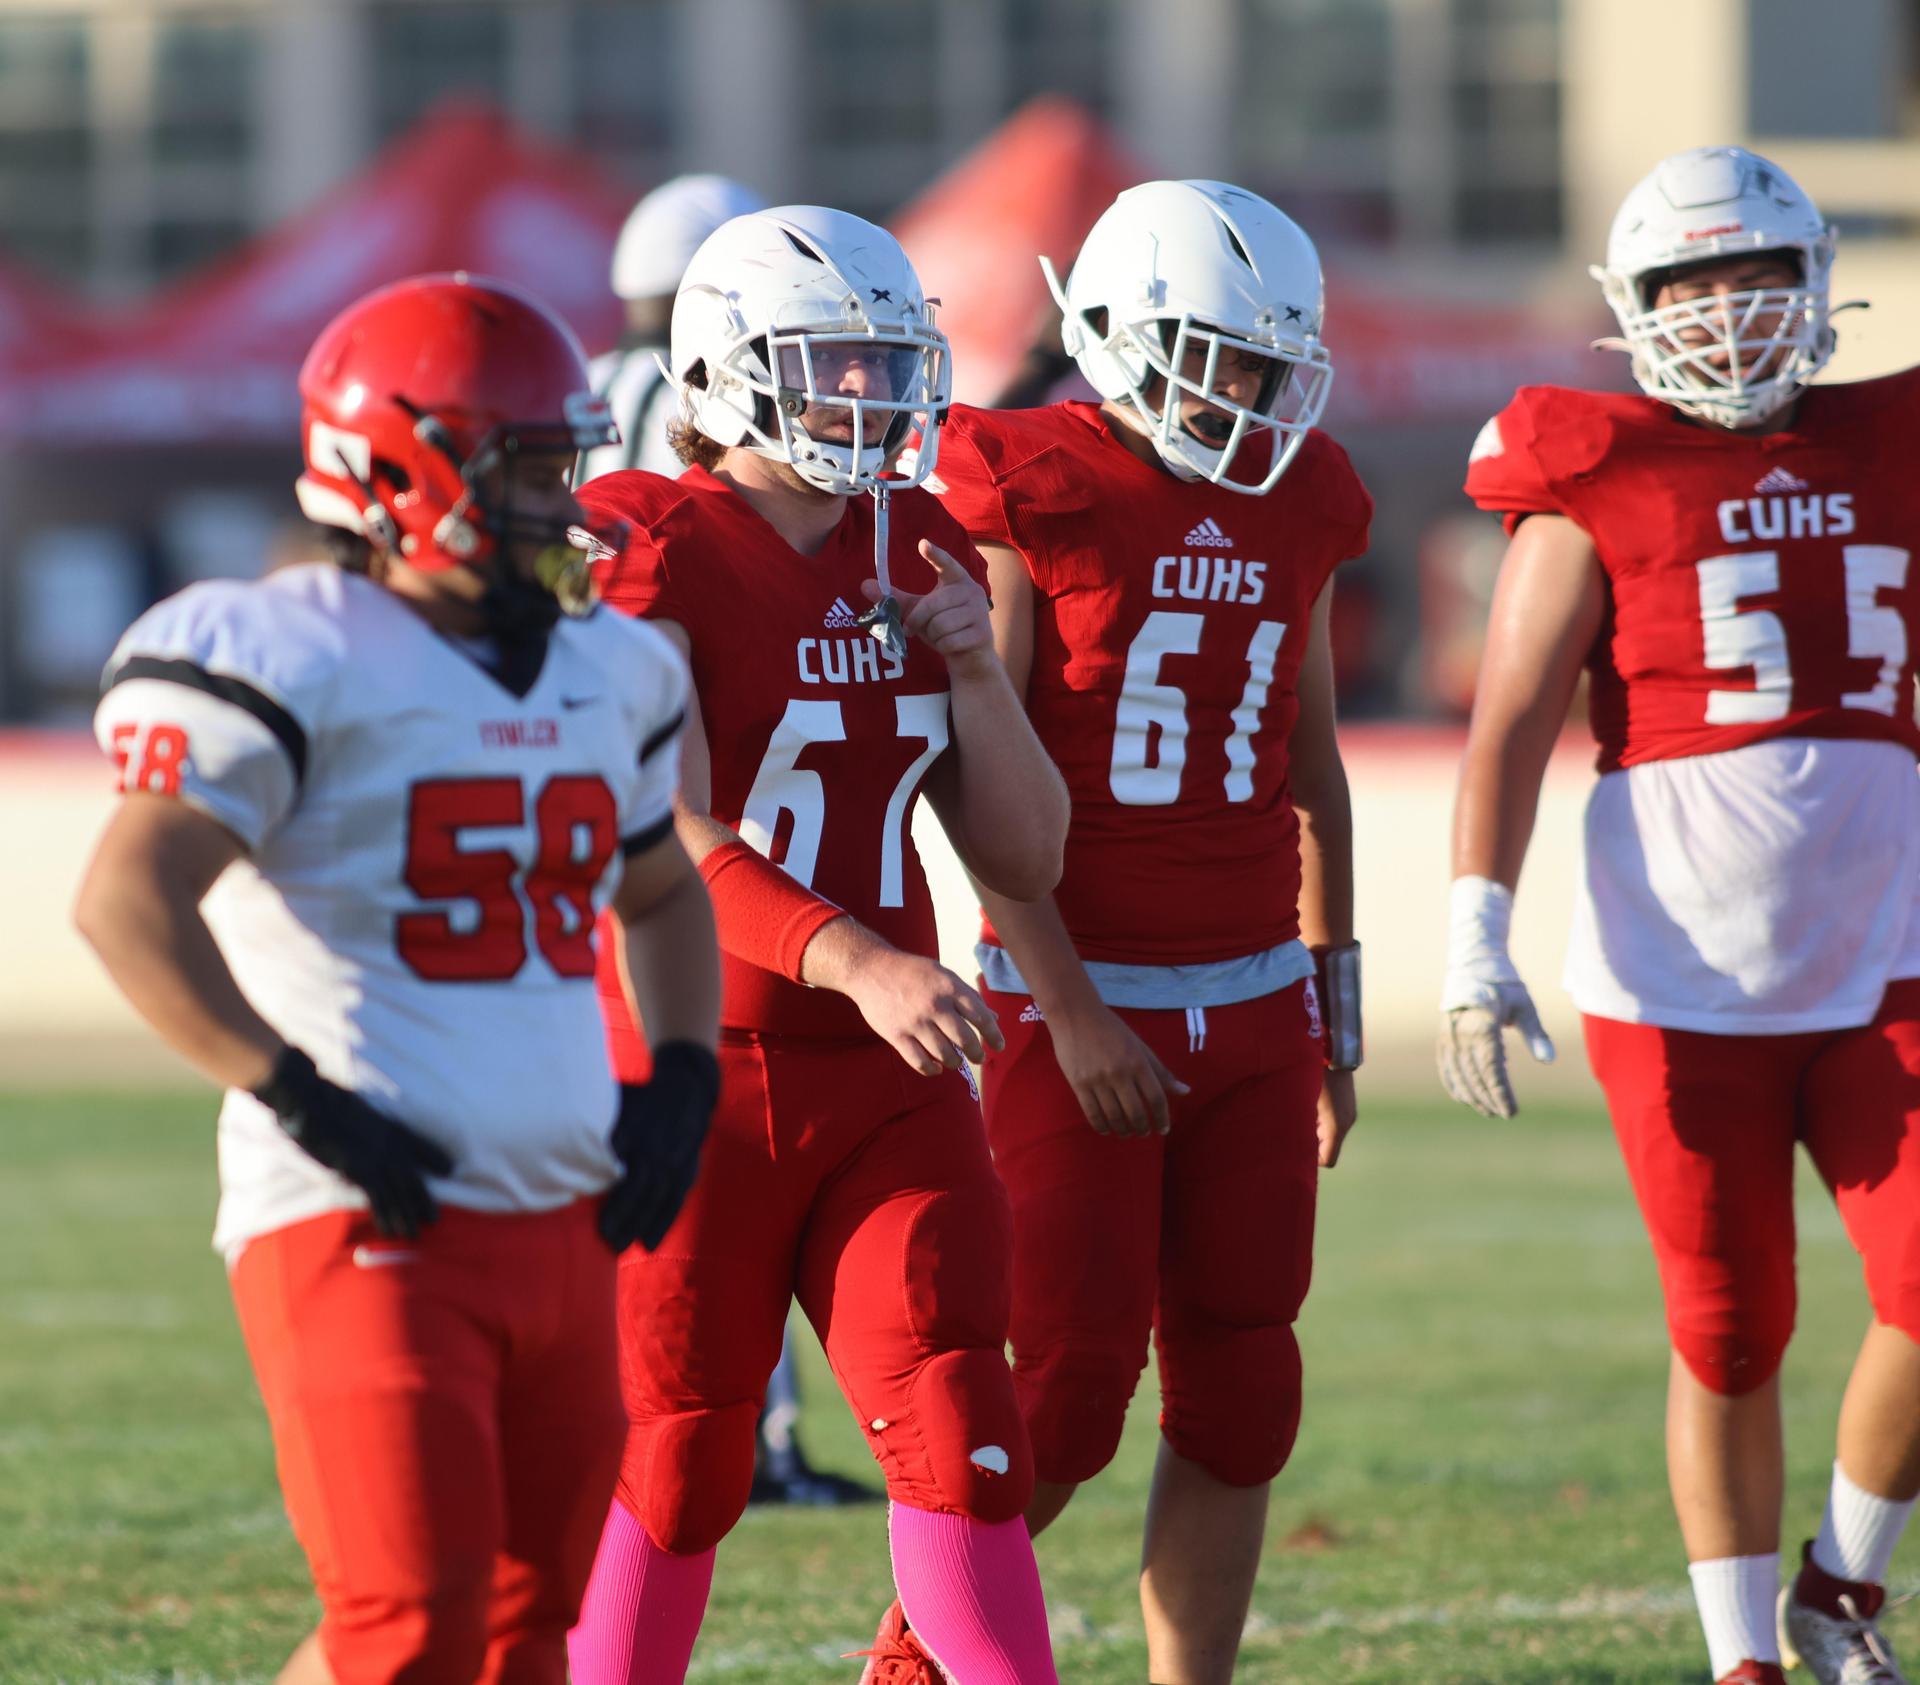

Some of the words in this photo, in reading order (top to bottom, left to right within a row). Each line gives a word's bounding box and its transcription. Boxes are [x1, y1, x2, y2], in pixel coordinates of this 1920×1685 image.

[1184, 534, 1233, 548] adidas
[1717, 493, 1856, 543] CUHS
[1151, 556, 1267, 605] CUHS
[823, 615, 859, 629] adid
[1696, 544, 1911, 726] 55
[797, 637, 904, 684] CUHS
[1109, 611, 1287, 806] 61
[738, 690, 950, 908] 67
[394, 773, 618, 982] 58
